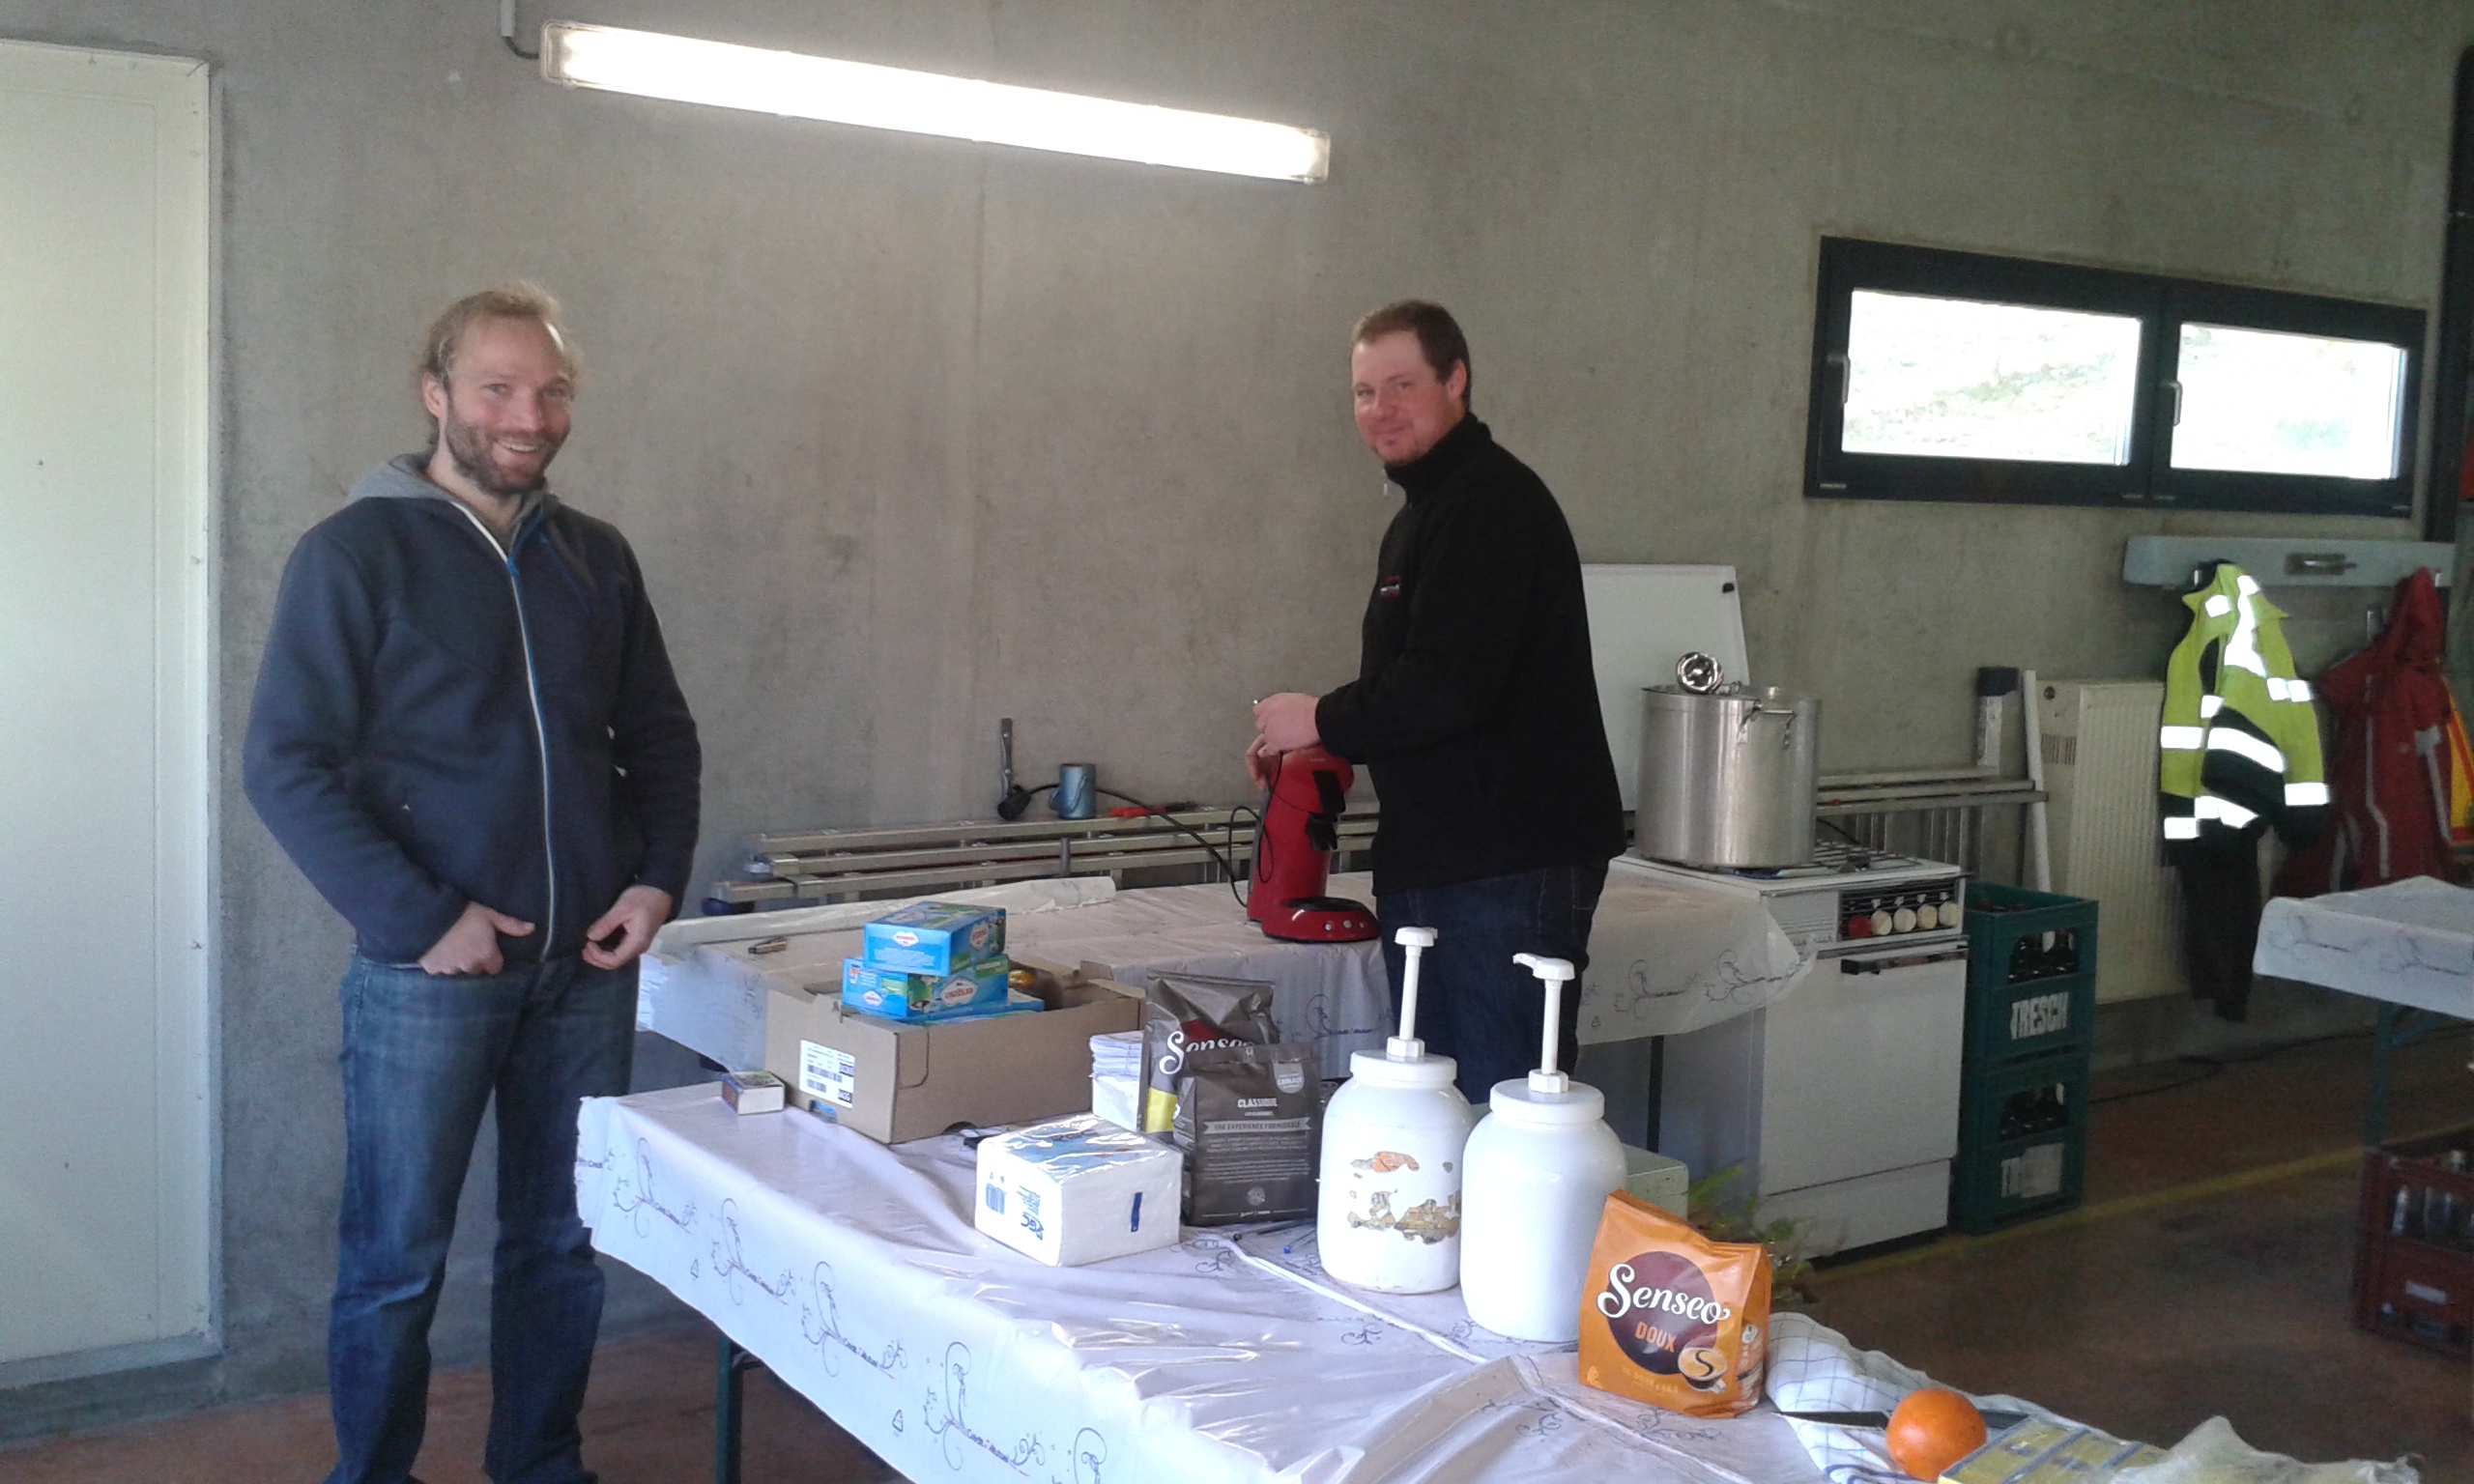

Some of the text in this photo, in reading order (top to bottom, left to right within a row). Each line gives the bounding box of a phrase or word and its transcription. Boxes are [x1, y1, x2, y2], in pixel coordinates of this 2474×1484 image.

[2009, 991, 2069, 1041] TRESCH
[1597, 1263, 1731, 1325] Senseo
[1635, 1321, 1677, 1353] DOUX
